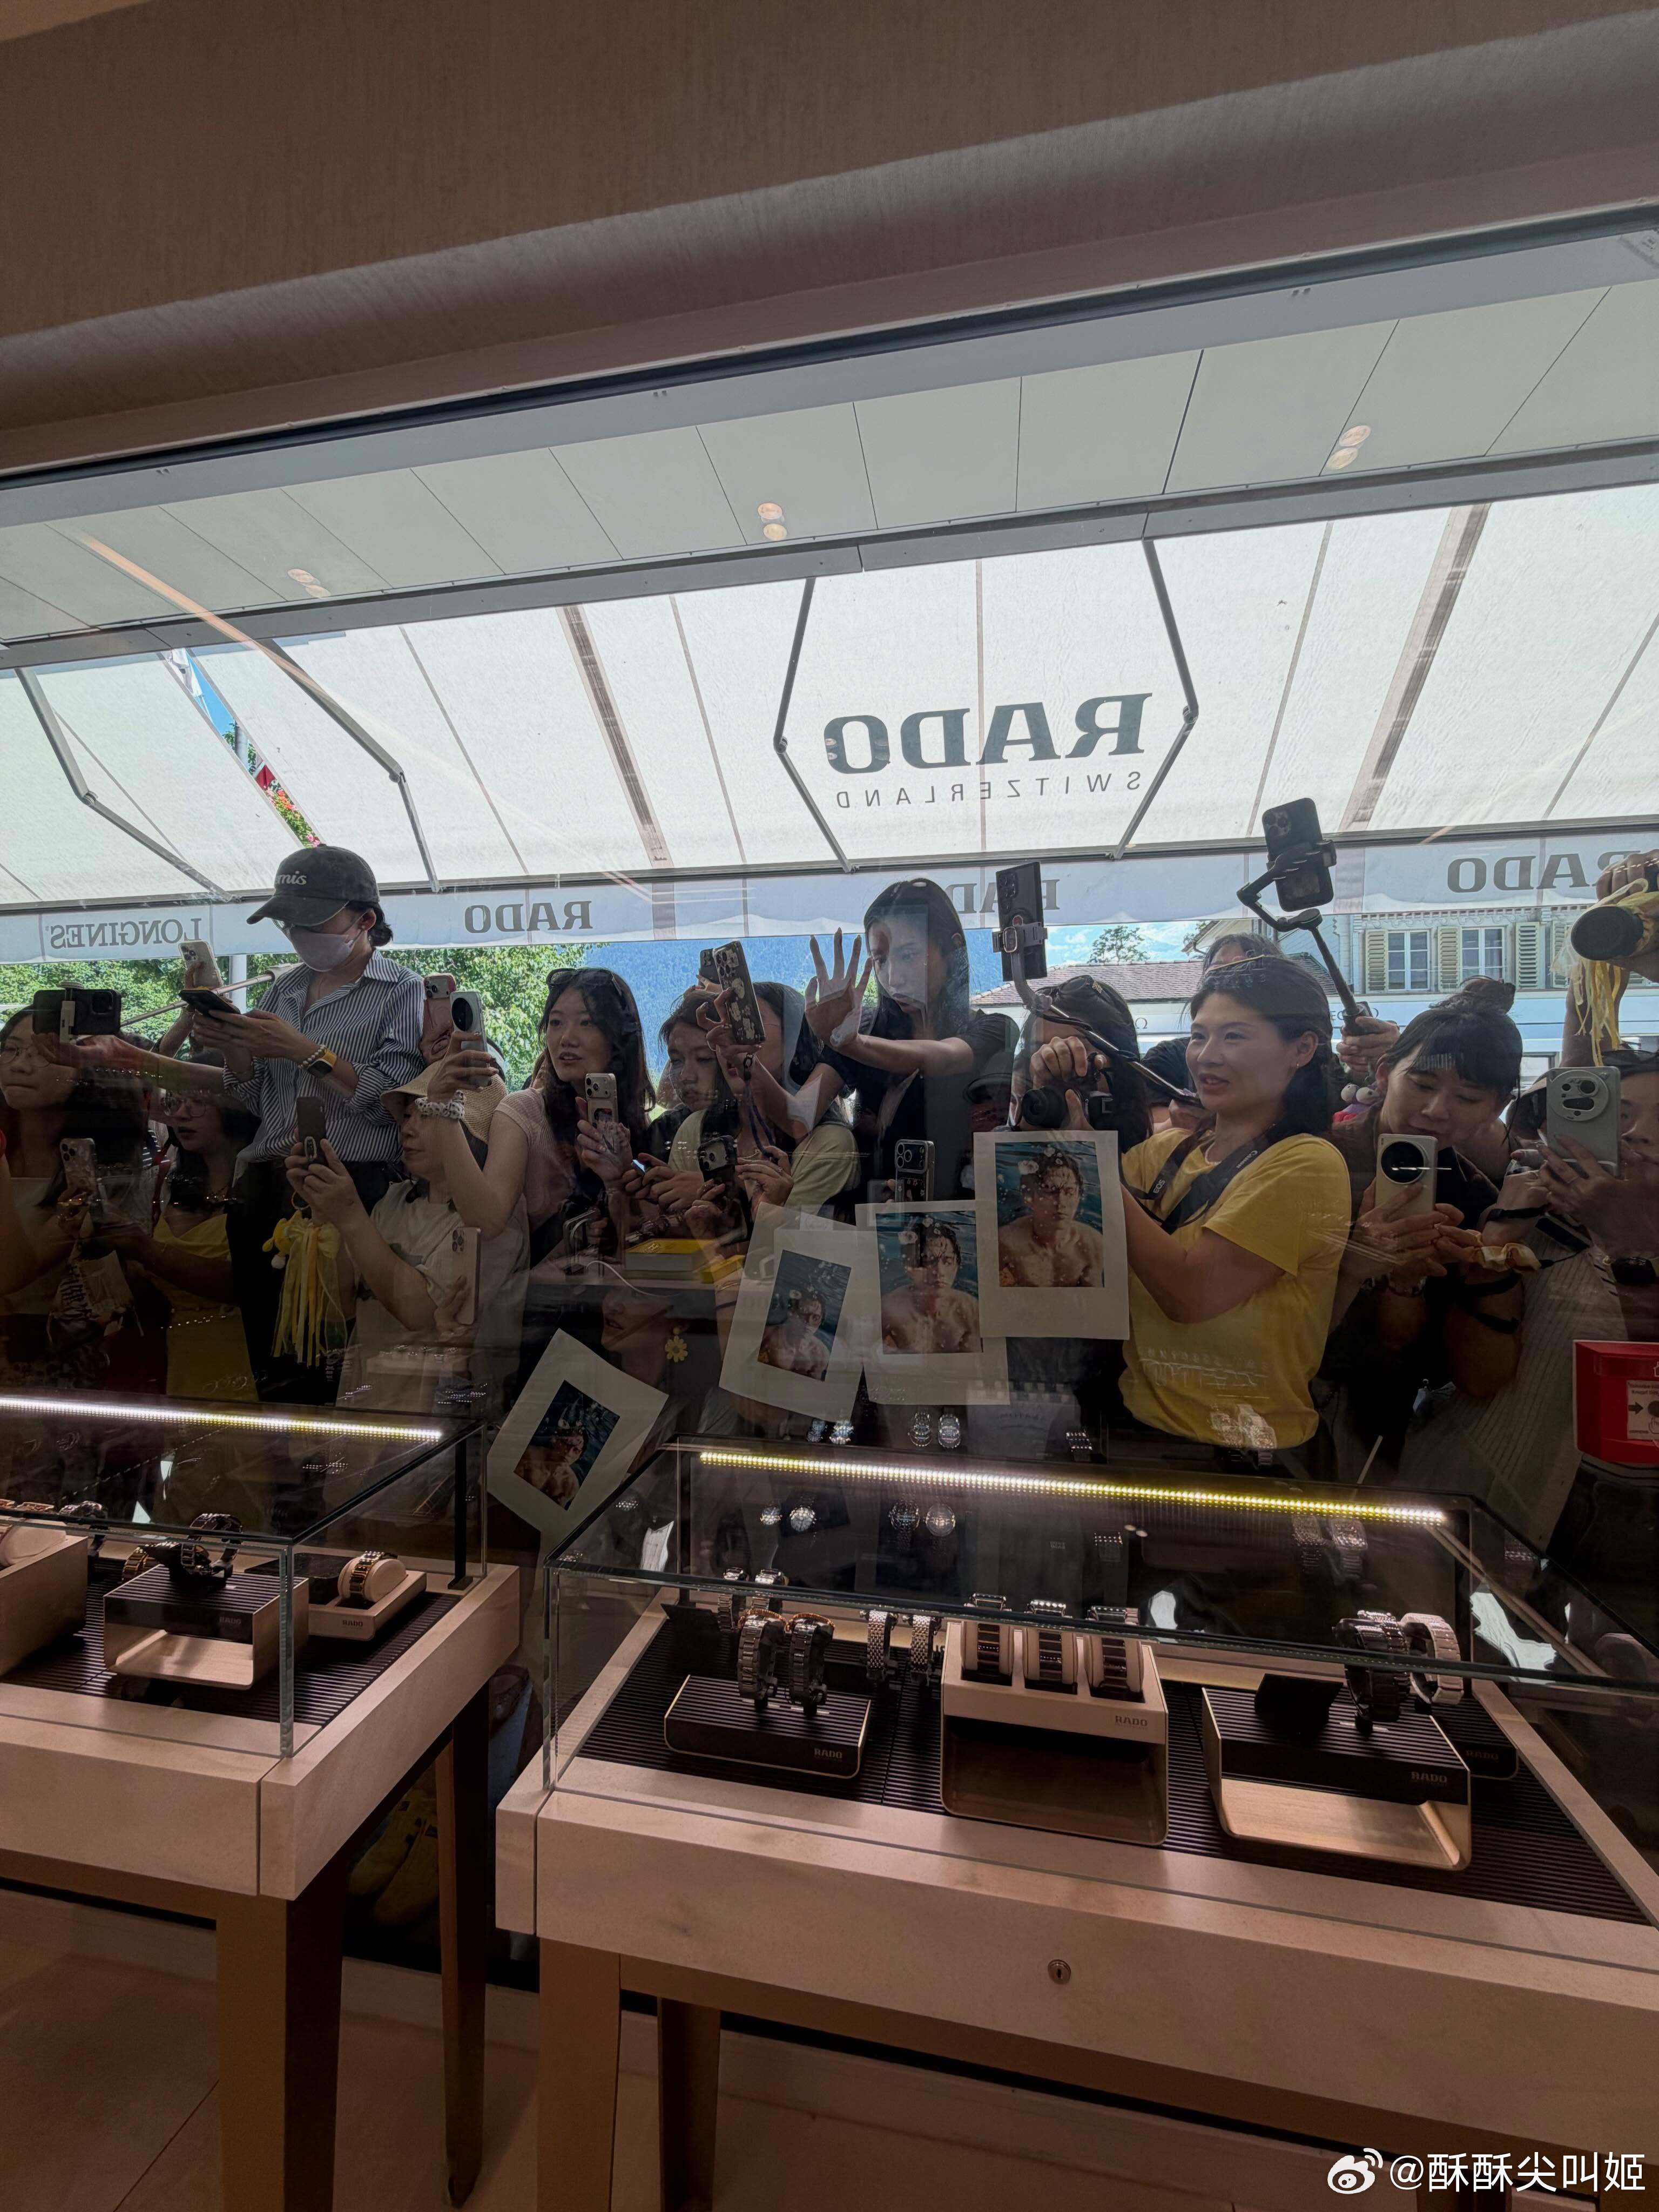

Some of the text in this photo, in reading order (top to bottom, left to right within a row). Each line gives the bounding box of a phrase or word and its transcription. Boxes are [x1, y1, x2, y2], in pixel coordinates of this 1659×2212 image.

[1153, 1179, 1166, 1194] EOS
[1115, 1715, 1148, 1727] RADO
[814, 1748, 842, 1759] RADO
[1411, 1771, 1448, 1783] RADO
